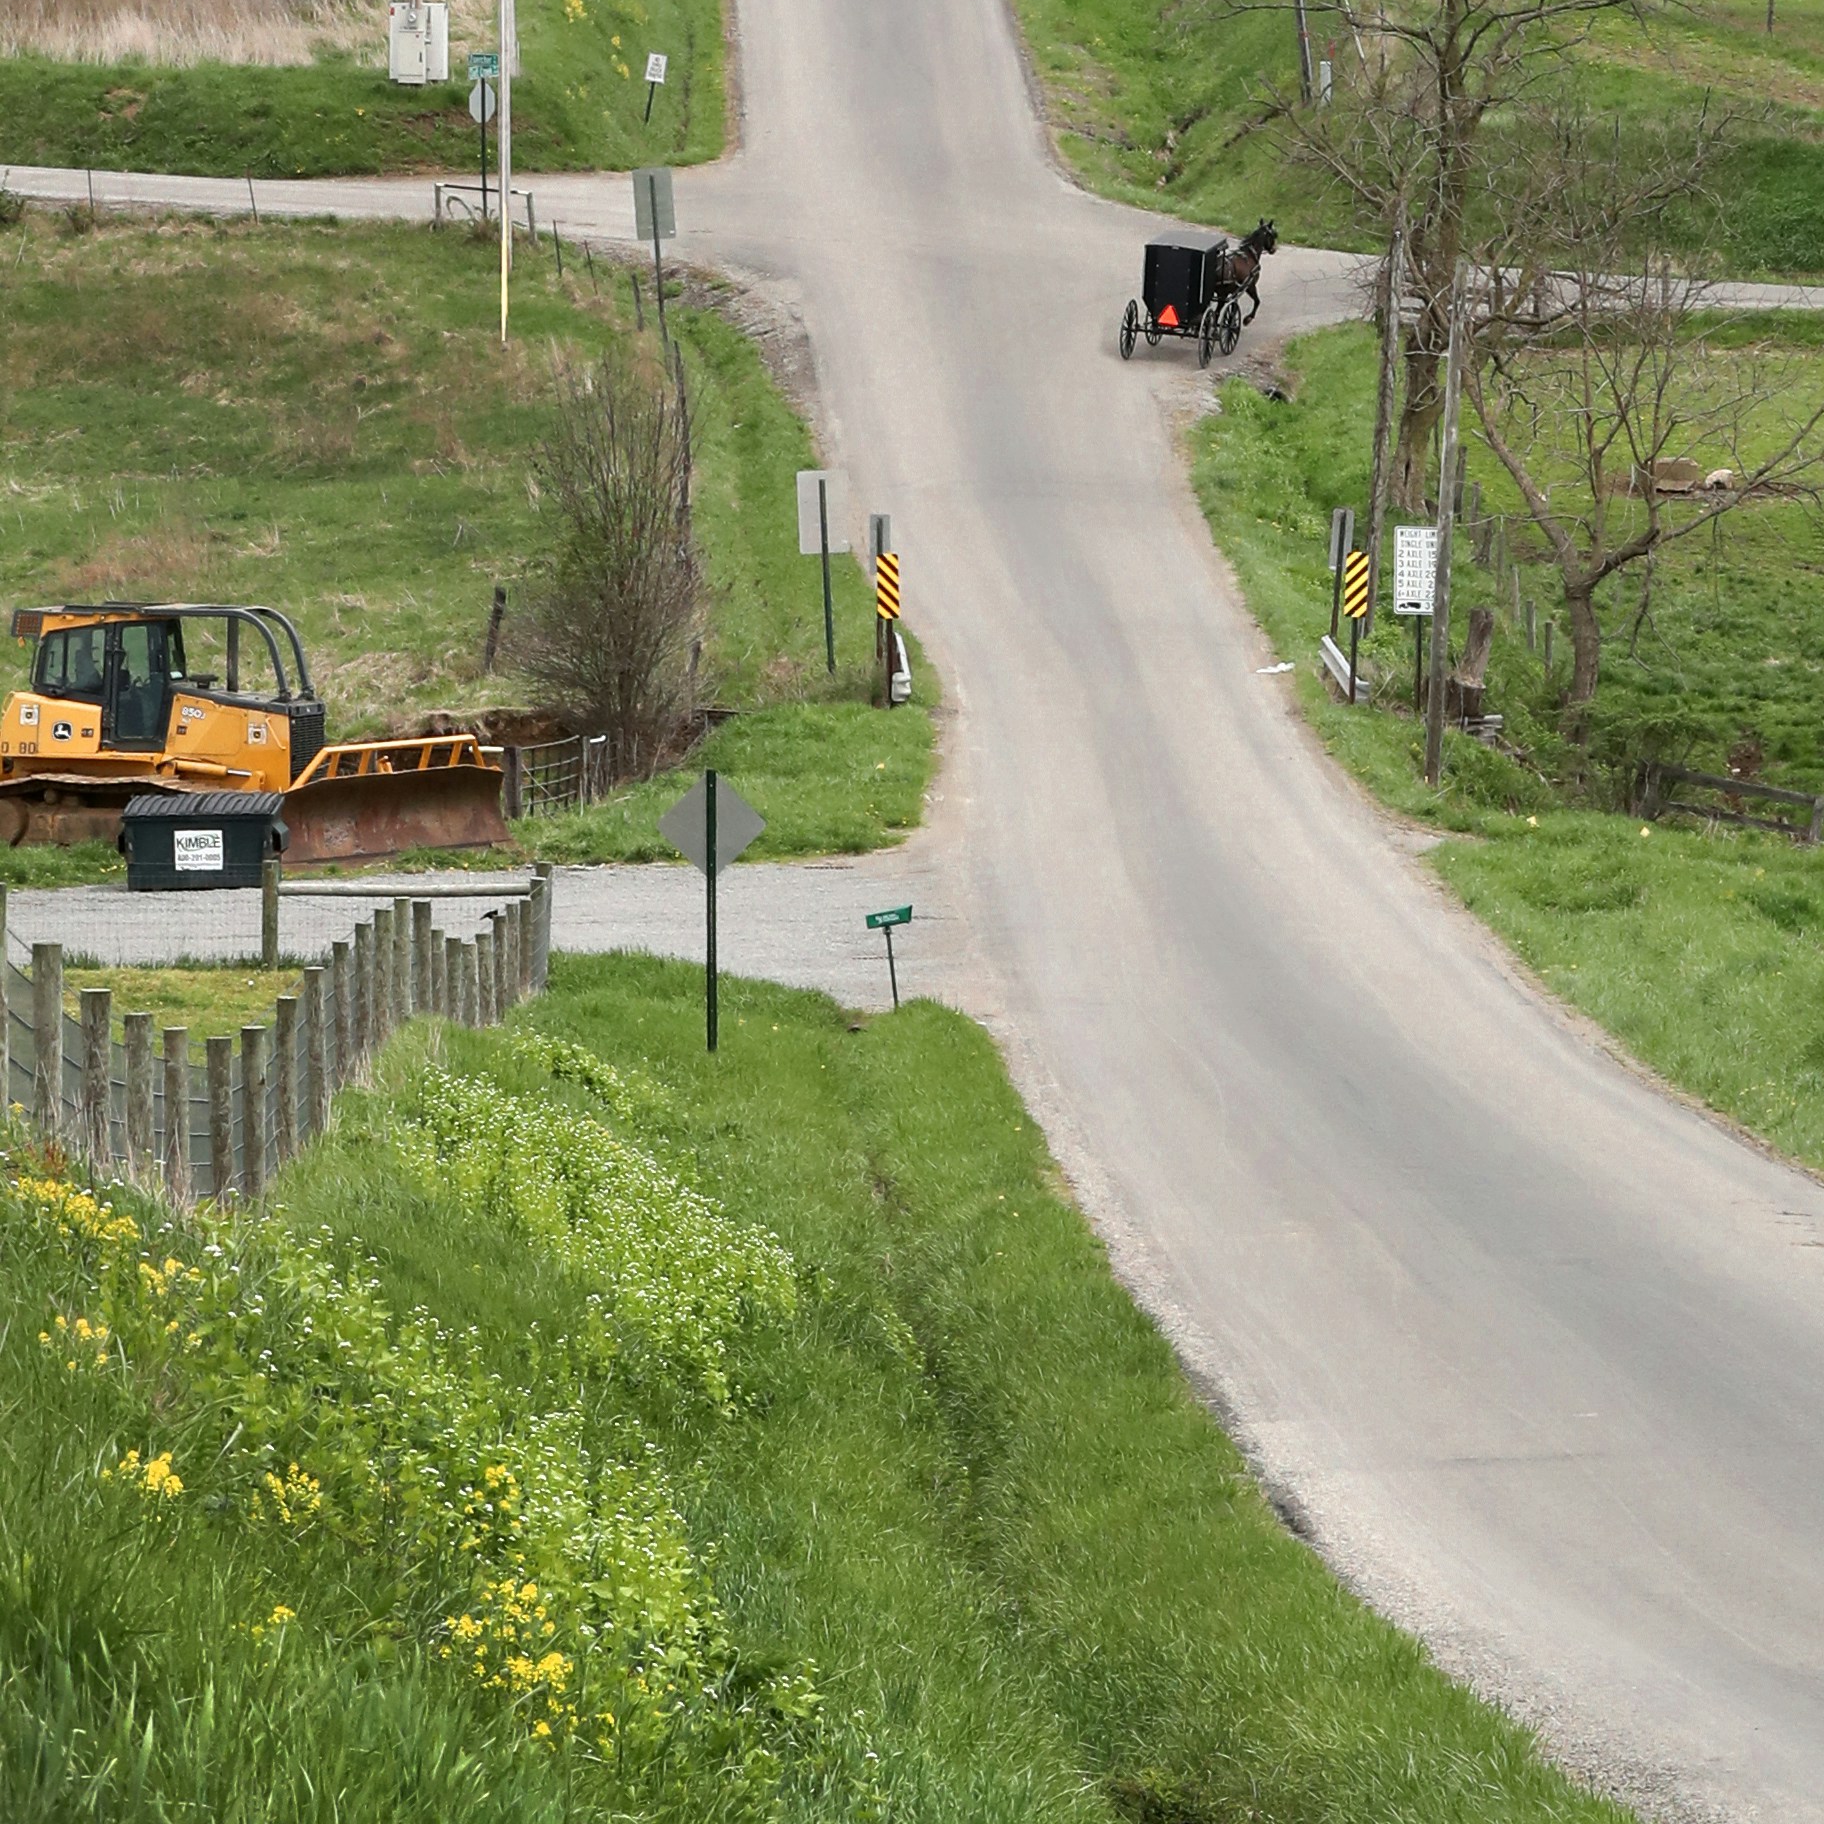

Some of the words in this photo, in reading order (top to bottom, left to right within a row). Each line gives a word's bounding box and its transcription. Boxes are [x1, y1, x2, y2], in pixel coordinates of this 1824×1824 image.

[1400, 540, 1422, 548] SINGLE
[1407, 550, 1423, 558] AXLE
[1407, 560, 1423, 568] AXLE
[1407, 570, 1423, 578] AXLE
[1398, 579, 1404, 587] 5
[1407, 580, 1423, 588] AXLE
[1406, 590, 1421, 598] AXLE
[176, 836, 221, 848] KIMBLE
